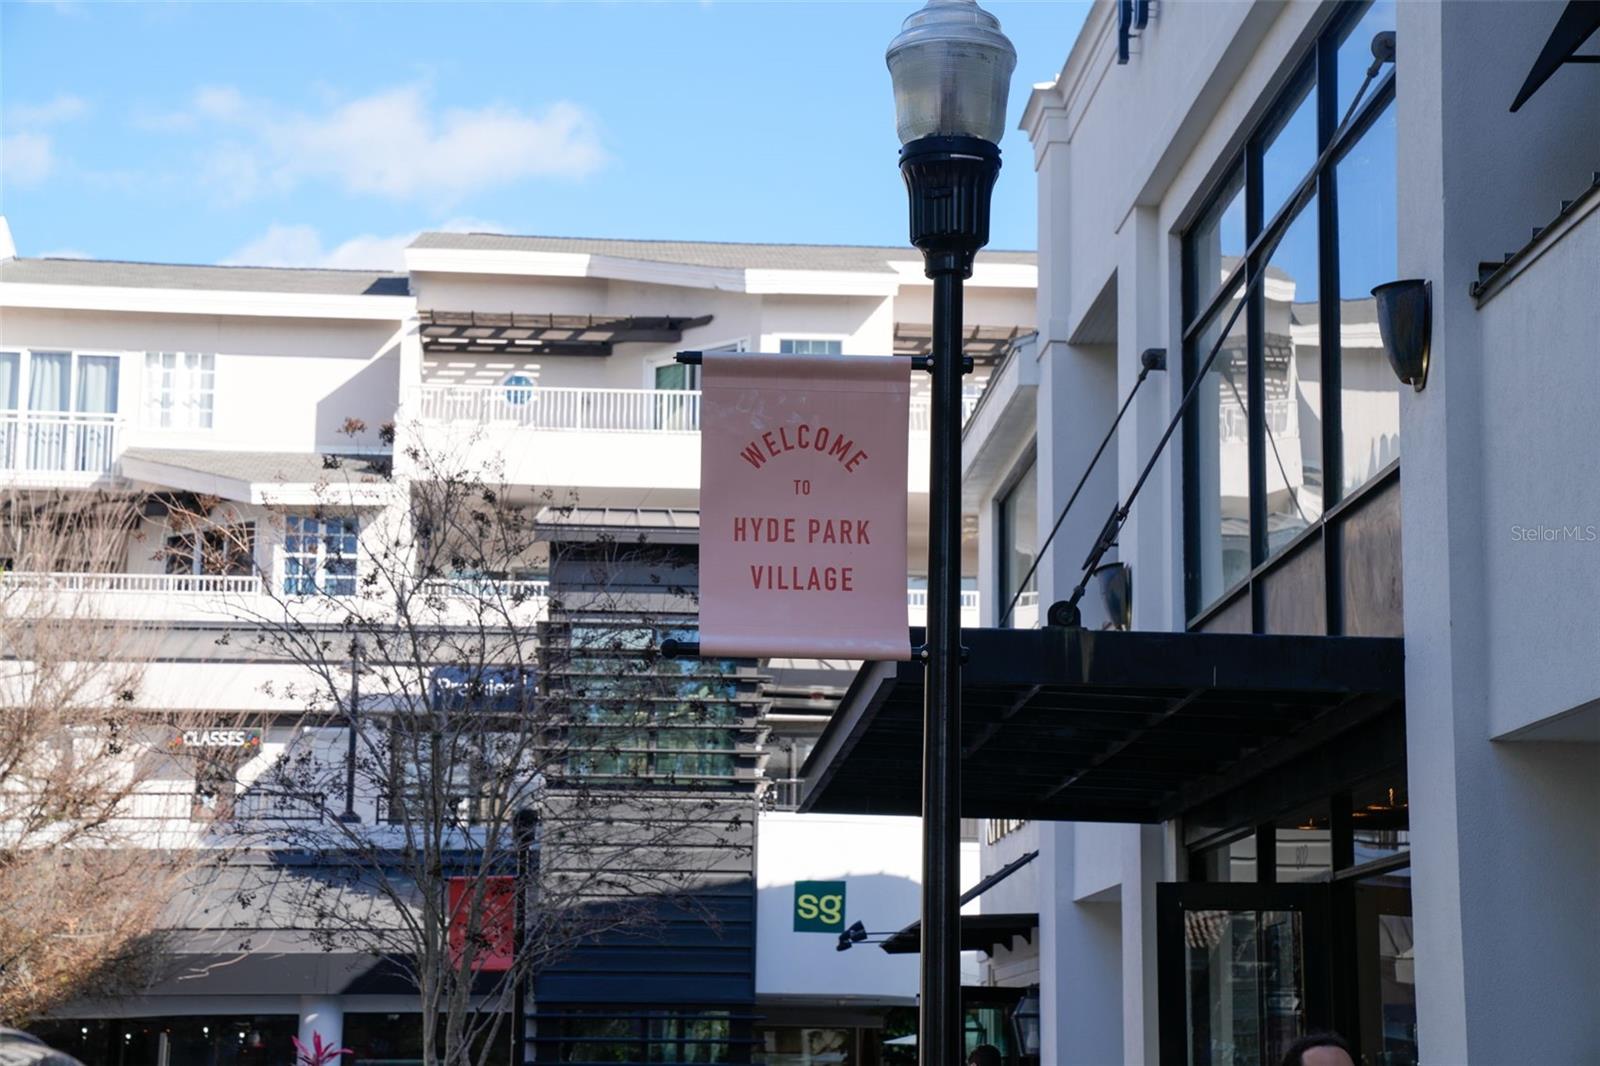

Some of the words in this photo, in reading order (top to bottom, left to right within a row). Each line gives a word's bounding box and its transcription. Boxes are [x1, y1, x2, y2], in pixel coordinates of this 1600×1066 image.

[740, 424, 868, 473] WELCOME
[793, 480, 811, 496] TO
[734, 518, 795, 543] HYDE
[808, 519, 870, 545] PARK
[751, 566, 853, 592] VILLAGE
[182, 731, 246, 746] CLASSES
[798, 894, 842, 925] sg
